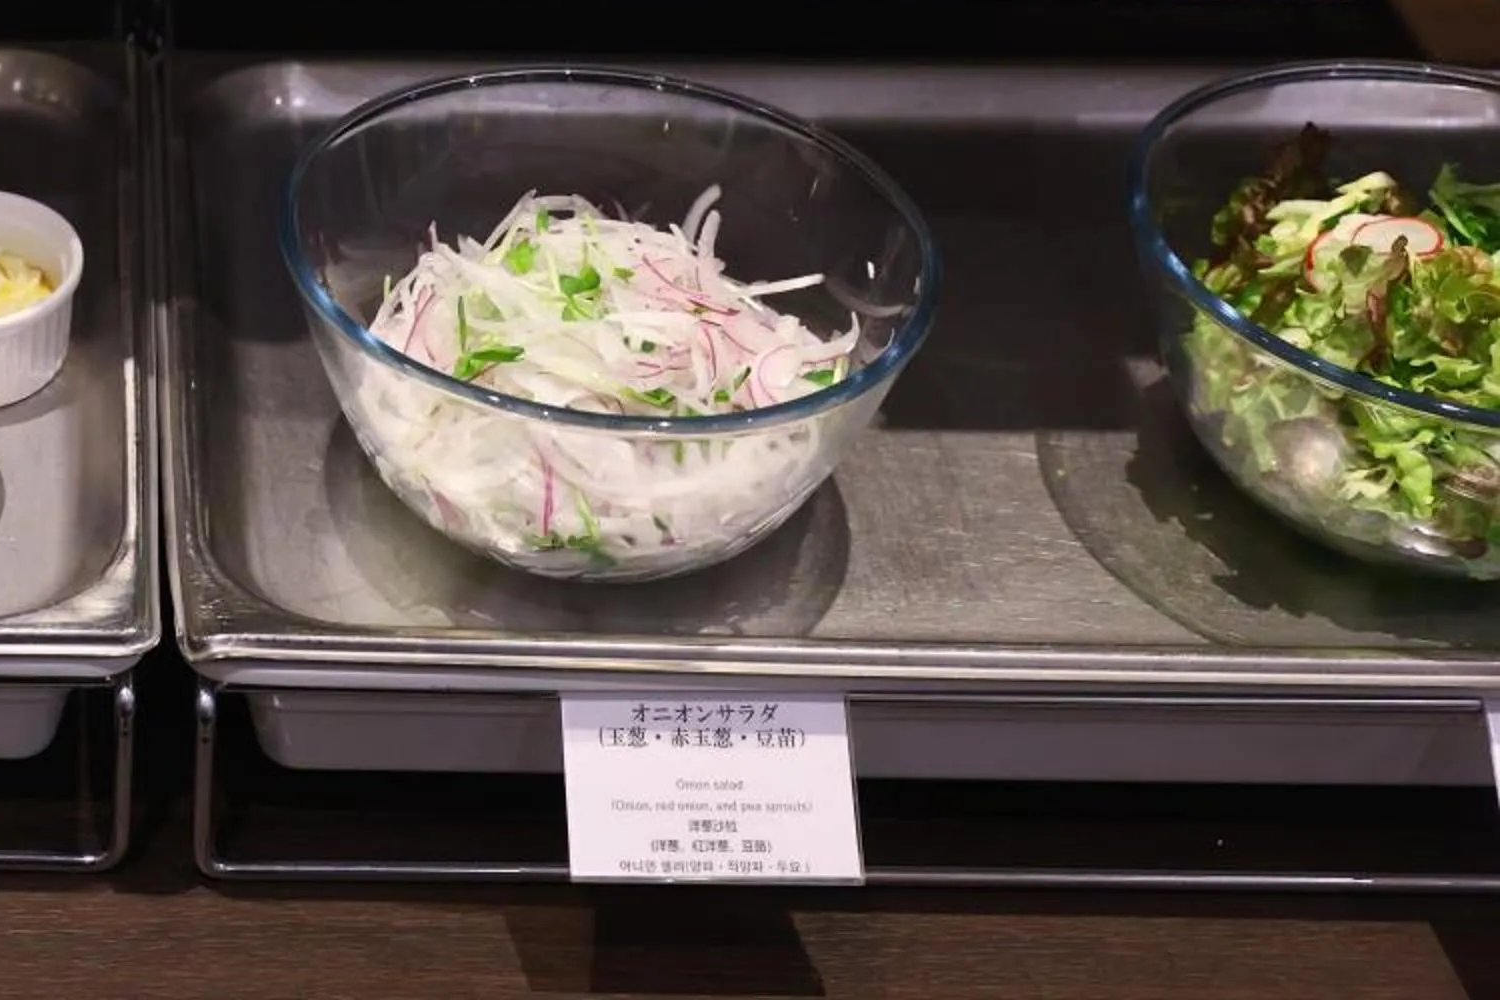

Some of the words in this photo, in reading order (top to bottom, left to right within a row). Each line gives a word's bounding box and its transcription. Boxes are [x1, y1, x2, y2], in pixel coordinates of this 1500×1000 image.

[632, 703, 779, 724] オニオンサラダ
